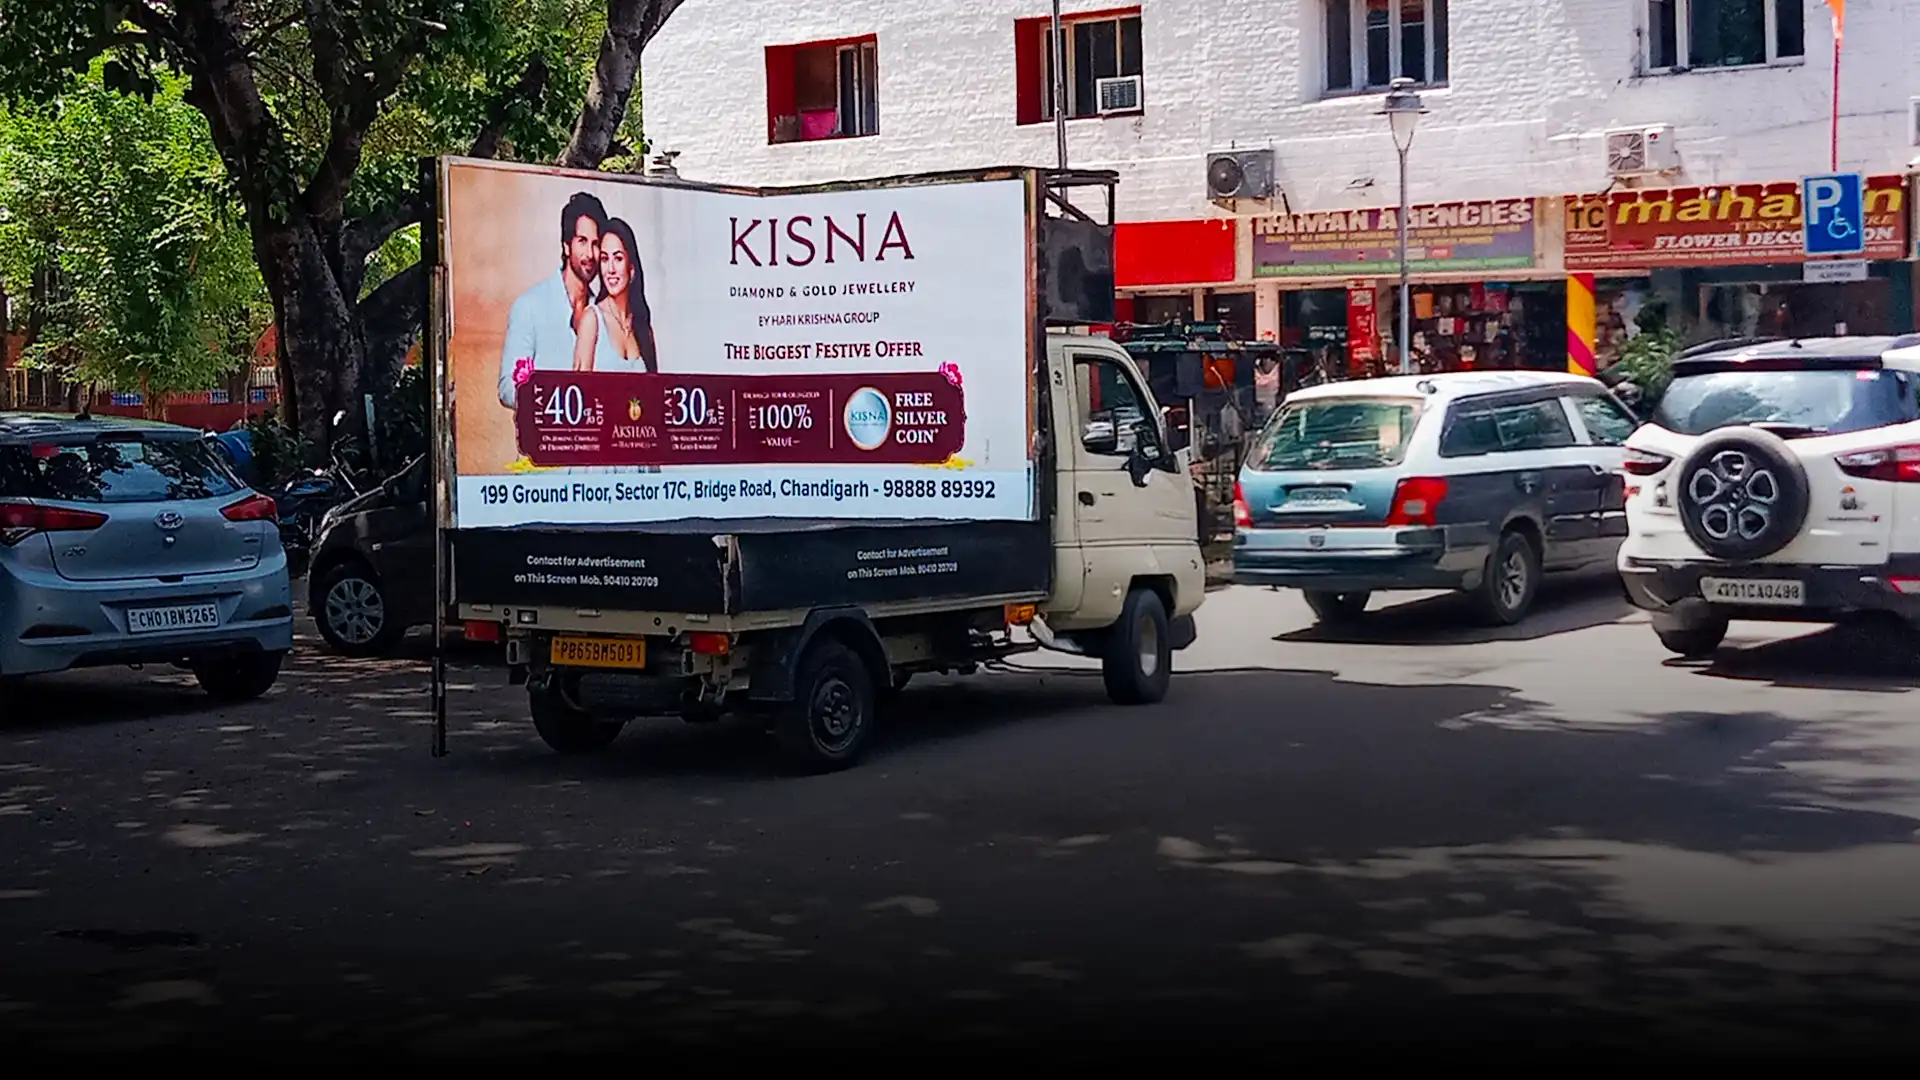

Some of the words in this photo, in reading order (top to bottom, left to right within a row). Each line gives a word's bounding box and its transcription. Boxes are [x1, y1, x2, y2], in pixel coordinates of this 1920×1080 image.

[1615, 187, 1902, 225] mahan
[1808, 179, 1842, 225] P
[1256, 210, 1369, 235] RAMAN
[1378, 202, 1532, 230] AGENCIES
[1569, 206, 1604, 229] TC
[729, 211, 915, 267] KISNA
[1654, 231, 1741, 249] FLOWER
[1747, 226, 1895, 245] DECOON
[730, 286, 784, 298] DIAMOND
[789, 286, 797, 297] &
[803, 285, 837, 297] GOLD
[842, 281, 915, 296] JEWELLERY
[771, 315, 796, 326] HARI
[798, 313, 842, 325] KRISHNA
[844, 312, 880, 324] GROUP
[895, 392, 933, 407] FREE
[850, 411, 885, 421] KISNA
[895, 411, 947, 426] SILVER
[480, 485, 508, 505] 199
[512, 484, 568, 503] Ground
[573, 483, 612, 505] Floor,
[615, 482, 659, 501] Sector
[662, 481, 691, 501] 17C,
[694, 480, 736, 502] Bridge
[740, 479, 776, 500] Road,
[780, 478, 869, 501] Chandigarh
[883, 480, 936, 498] 98888
[940, 480, 995, 499] 89392
[526, 555, 562, 565] Contact
[563, 555, 576, 566] for
[577, 556, 645, 568] Advertisement
[514, 574, 526, 583] on
[527, 573, 545, 583] This
[547, 574, 577, 584] Screen
[140, 607, 216, 627] CH01BN3265
